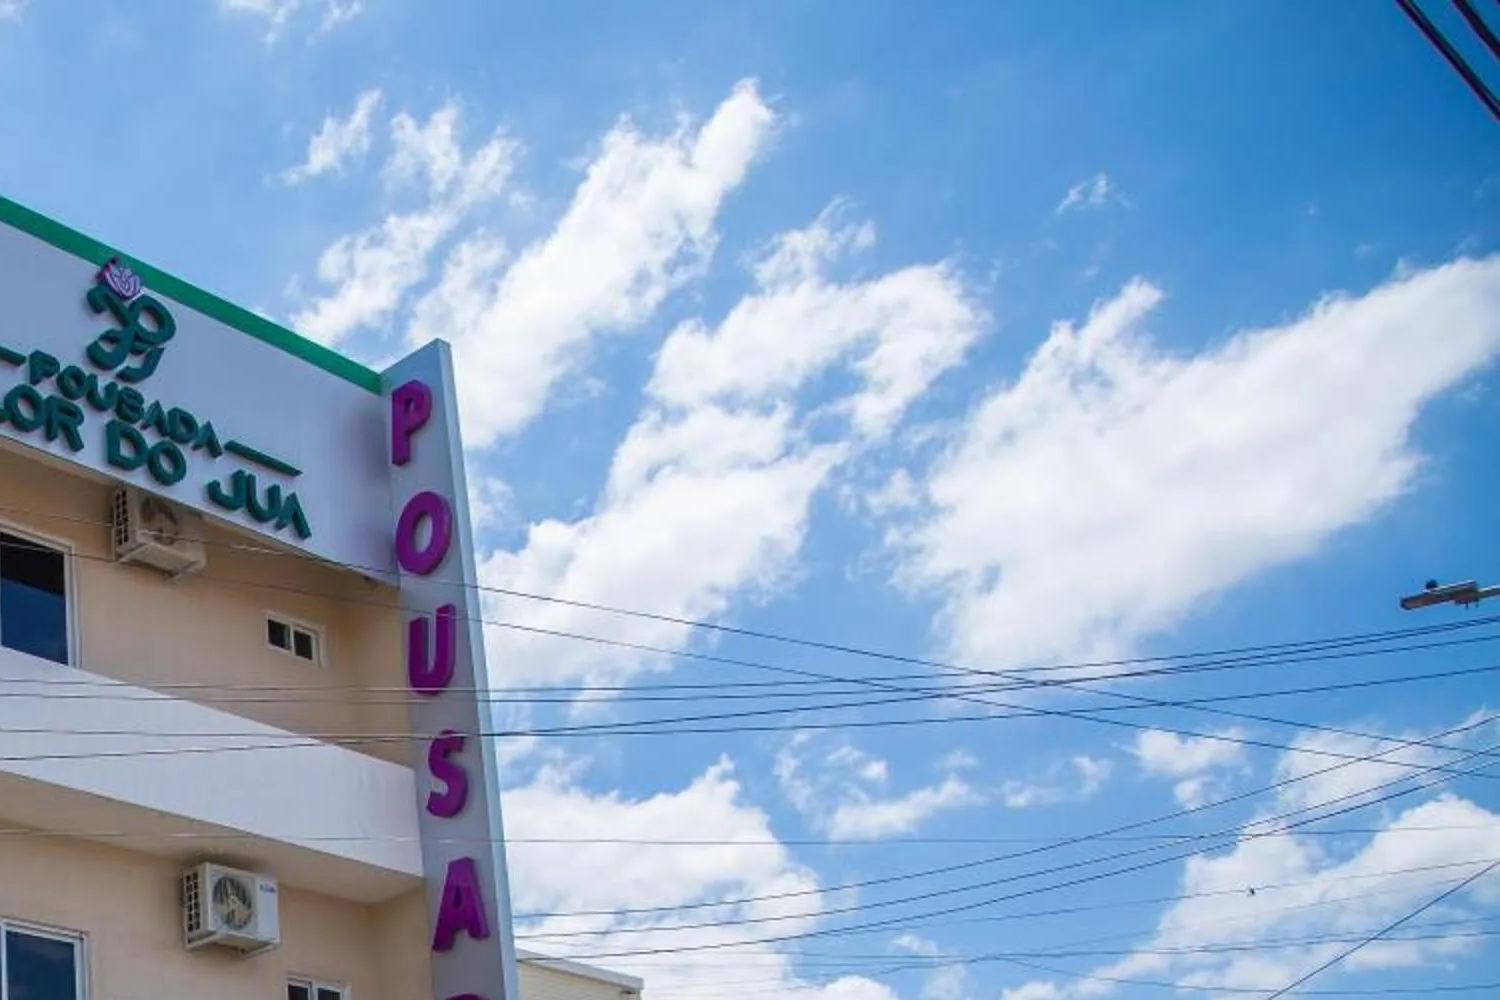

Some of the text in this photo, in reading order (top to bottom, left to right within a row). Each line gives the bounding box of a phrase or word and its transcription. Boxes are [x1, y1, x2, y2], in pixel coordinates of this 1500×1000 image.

[29, 350, 223, 458] POUSADA
[105, 419, 187, 486] DO
[207, 469, 313, 540] JUA
